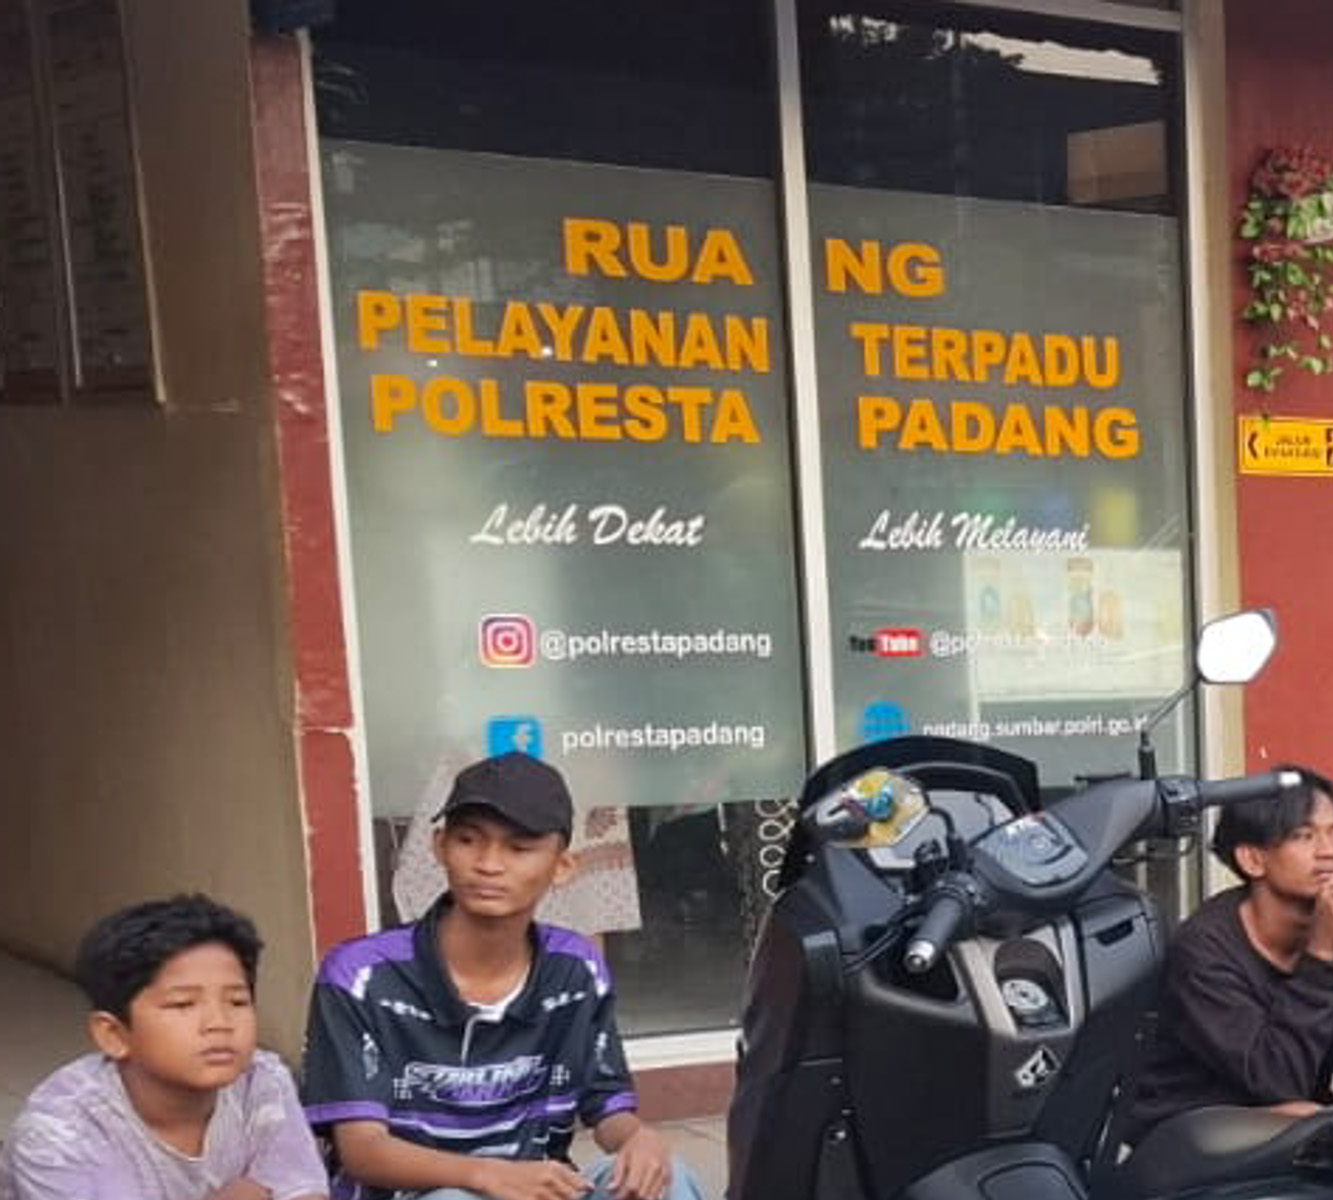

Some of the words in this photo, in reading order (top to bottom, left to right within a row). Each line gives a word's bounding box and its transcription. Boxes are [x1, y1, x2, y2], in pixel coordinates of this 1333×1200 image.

[562, 217, 755, 286] RUA
[824, 237, 946, 297] NG
[356, 289, 772, 374] PELAYANAN
[850, 321, 1121, 389] TERPADU
[369, 372, 762, 445] POLRESTA
[857, 395, 1143, 461] PADANG
[469, 503, 579, 546] Lebih
[587, 504, 705, 547] Dekat
[858, 510, 944, 551] Lebih
[952, 512, 1092, 553] Melayani
[541, 628, 773, 661] @polrestapadang
[561, 722, 767, 757] polrestapadang
